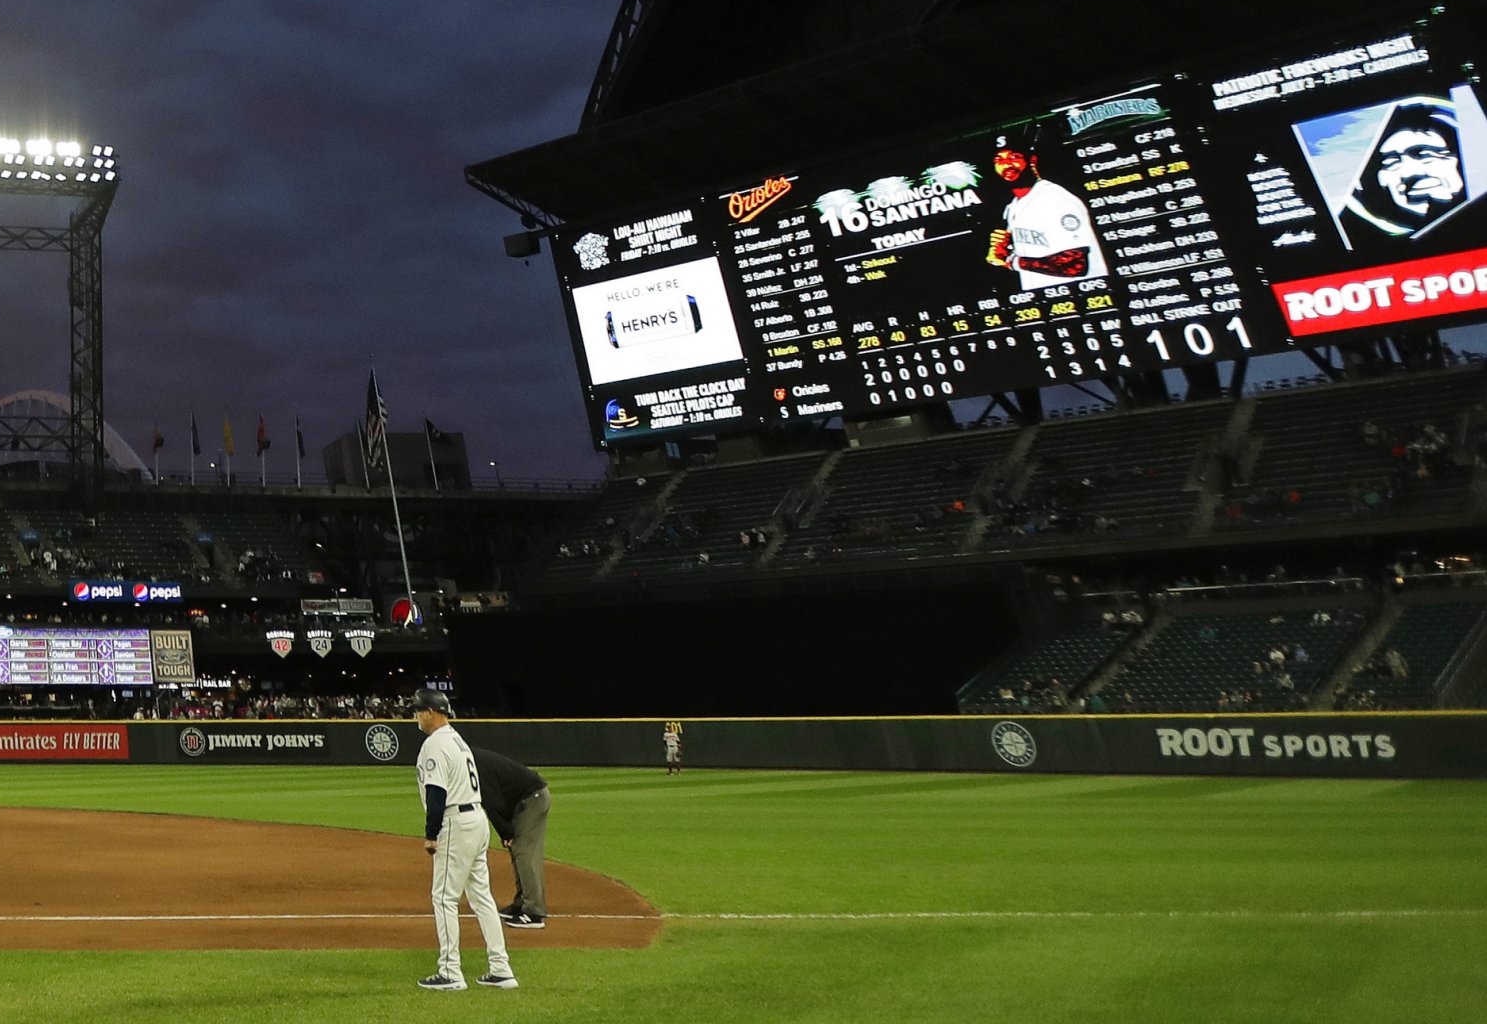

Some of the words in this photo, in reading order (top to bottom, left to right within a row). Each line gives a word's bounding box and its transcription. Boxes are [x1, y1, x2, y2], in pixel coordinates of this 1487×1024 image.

[1068, 98, 1161, 134] MARINERS
[728, 176, 791, 219] Orioles
[865, 182, 946, 212] DOMINGO
[870, 189, 982, 227] SANTANA
[646, 209, 693, 230] HAWAIIAN
[820, 202, 869, 236] 16
[628, 232, 654, 249] SHIRT
[655, 225, 682, 242] NIGHT
[872, 228, 926, 250] TODAY
[621, 249, 642, 262] FRIDAY
[862, 255, 896, 269] Strikeout
[865, 270, 886, 281] Walk
[761, 300, 780, 310] Ruiz
[852, 321, 874, 334] AVG
[888, 317, 898, 326] R
[918, 311, 930, 321] H
[946, 305, 966, 316] HR
[978, 298, 1000, 310] RBI
[1009, 292, 1036, 304] OBP
[1044, 286, 1070, 298] SLG
[1078, 279, 1108, 292] OPS
[1283, 277, 1395, 321] ROOT
[766, 314, 793, 326] Alberto
[1130, 313, 1164, 326] BALL
[1164, 304, 1212, 320] STRIKE
[1212, 298, 1242, 312] OUT
[890, 331, 906, 342] 40
[920, 326, 937, 338] 83
[953, 320, 968, 332] 15
[984, 315, 1002, 327] 54
[1146, 329, 1170, 360] 1
[1184, 323, 1214, 356] 0
[1226, 316, 1252, 348] 1
[777, 360, 802, 370] Bundy
[818, 354, 826, 363] P
[634, 394, 658, 406] TURN
[658, 389, 682, 403] BACK
[681, 386, 699, 399] THE
[698, 380, 728, 397] CLOCK
[727, 378, 746, 392] DAY
[792, 384, 830, 396] Orioles
[650, 403, 686, 418] SEATTLE
[687, 398, 716, 412] PILOTS
[716, 394, 735, 407] CAP
[797, 401, 844, 416] Mariners
[650, 415, 684, 429] SATURDAY
[713, 406, 742, 420] ORIOLES
[91, 584, 123, 599] pepsi
[150, 584, 181, 600] pepsi
[307, 629, 332, 638] GRIFFEY
[344, 629, 375, 639] MARTINEZ
[156, 636, 188, 650] BUILT
[274, 640, 288, 650] 42
[315, 640, 328, 650] 24
[358, 640, 367, 650] 11
[158, 664, 191, 676] TOUGH
[64, 732, 80, 750] FLY
[83, 732, 120, 750] BETTER
[208, 734, 262, 750] JIMMY
[266, 734, 324, 750] JOHN'S
[1156, 728, 1254, 756] ROOT
[1264, 735, 1395, 758] SPORTS
[466, 757, 478, 792] 6
